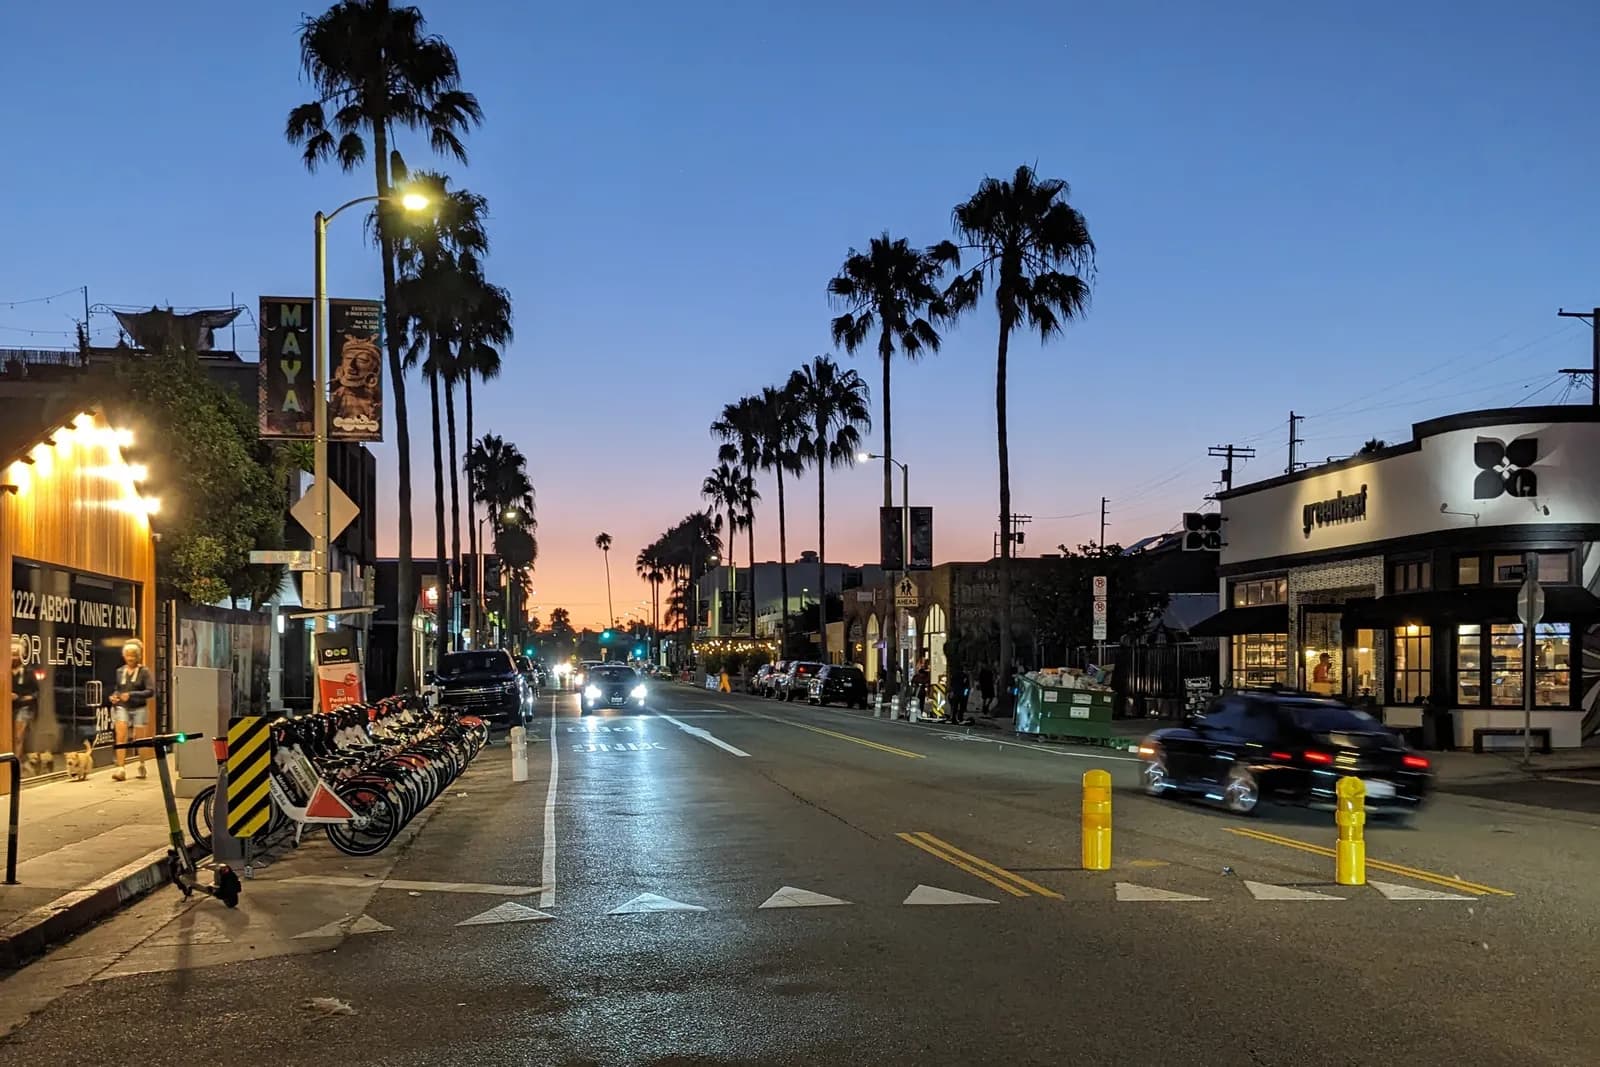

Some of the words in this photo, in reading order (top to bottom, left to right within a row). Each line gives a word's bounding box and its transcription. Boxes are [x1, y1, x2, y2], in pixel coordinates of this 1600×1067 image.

[281, 304, 302, 413] MAYA
[1303, 484, 1368, 535] greenleaf
[11, 589, 36, 619] 1222
[40, 594, 77, 624] ABBOT
[80, 600, 113, 628] KINNEY
[115, 605, 137, 630] BLVD
[48, 637, 92, 666] LEASE
[276, 774, 289, 791] Metro
[287, 790, 297, 802] Bike
[291, 765, 304, 781] Metro
[301, 780, 311, 792] Bike
[276, 793, 287, 806] Bike
